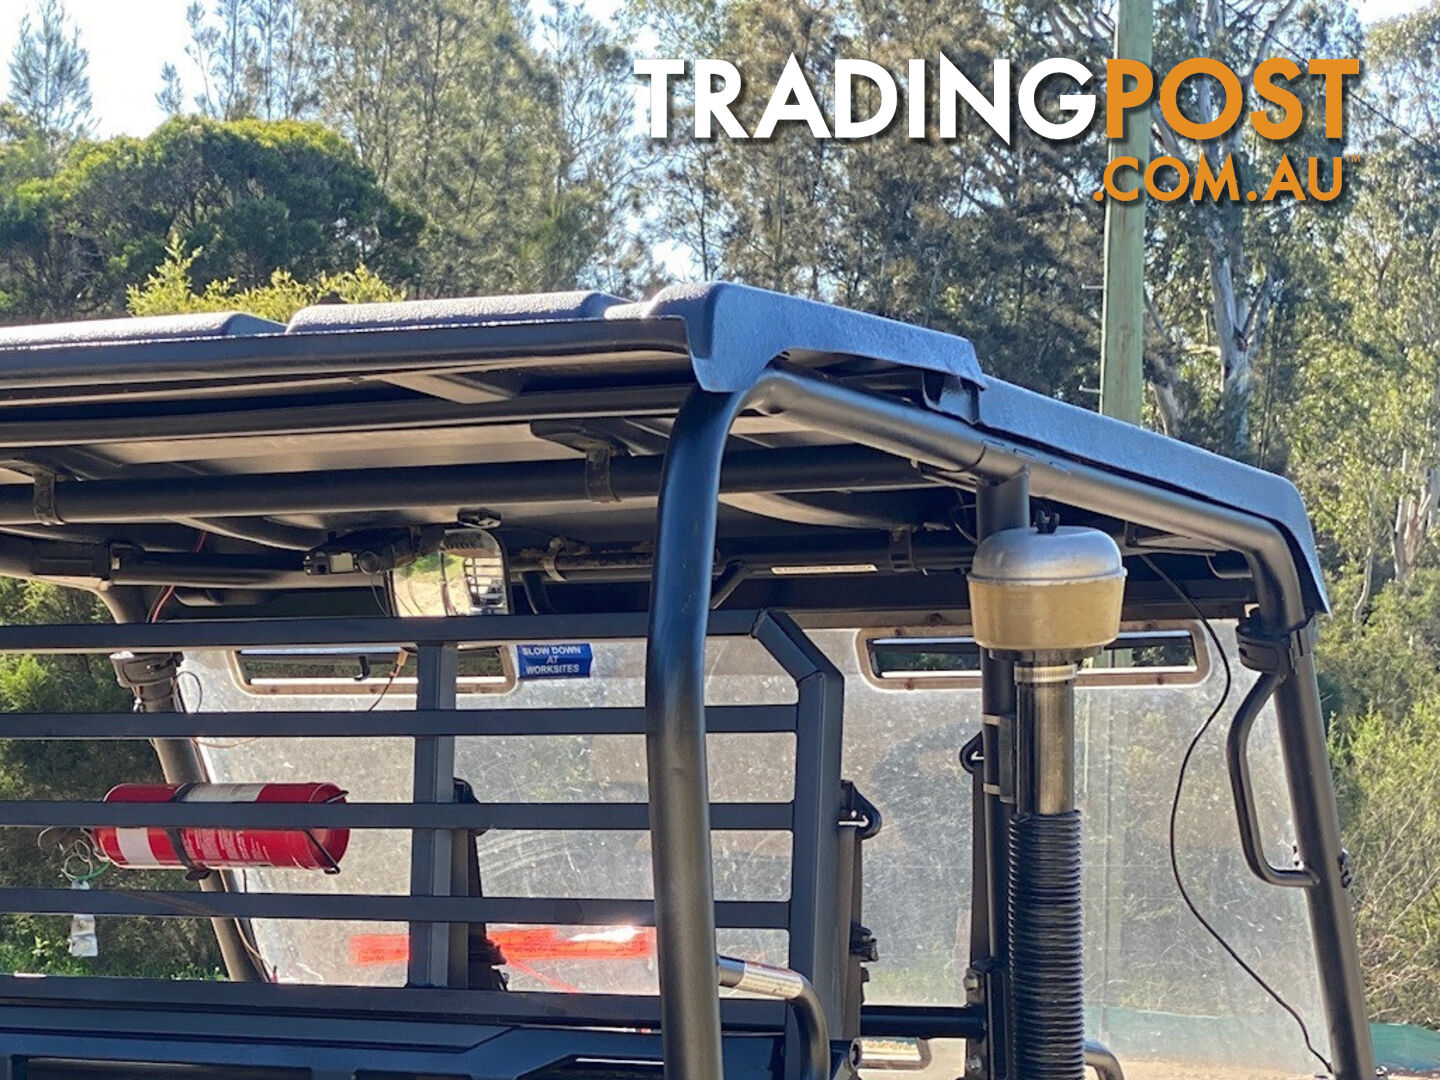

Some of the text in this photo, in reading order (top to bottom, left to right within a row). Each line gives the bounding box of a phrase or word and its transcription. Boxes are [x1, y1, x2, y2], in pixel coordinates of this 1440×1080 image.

[522, 646, 581, 656] SLOW DOWN
[546, 655, 558, 664] AT
[526, 664, 580, 674] WORKSITES
